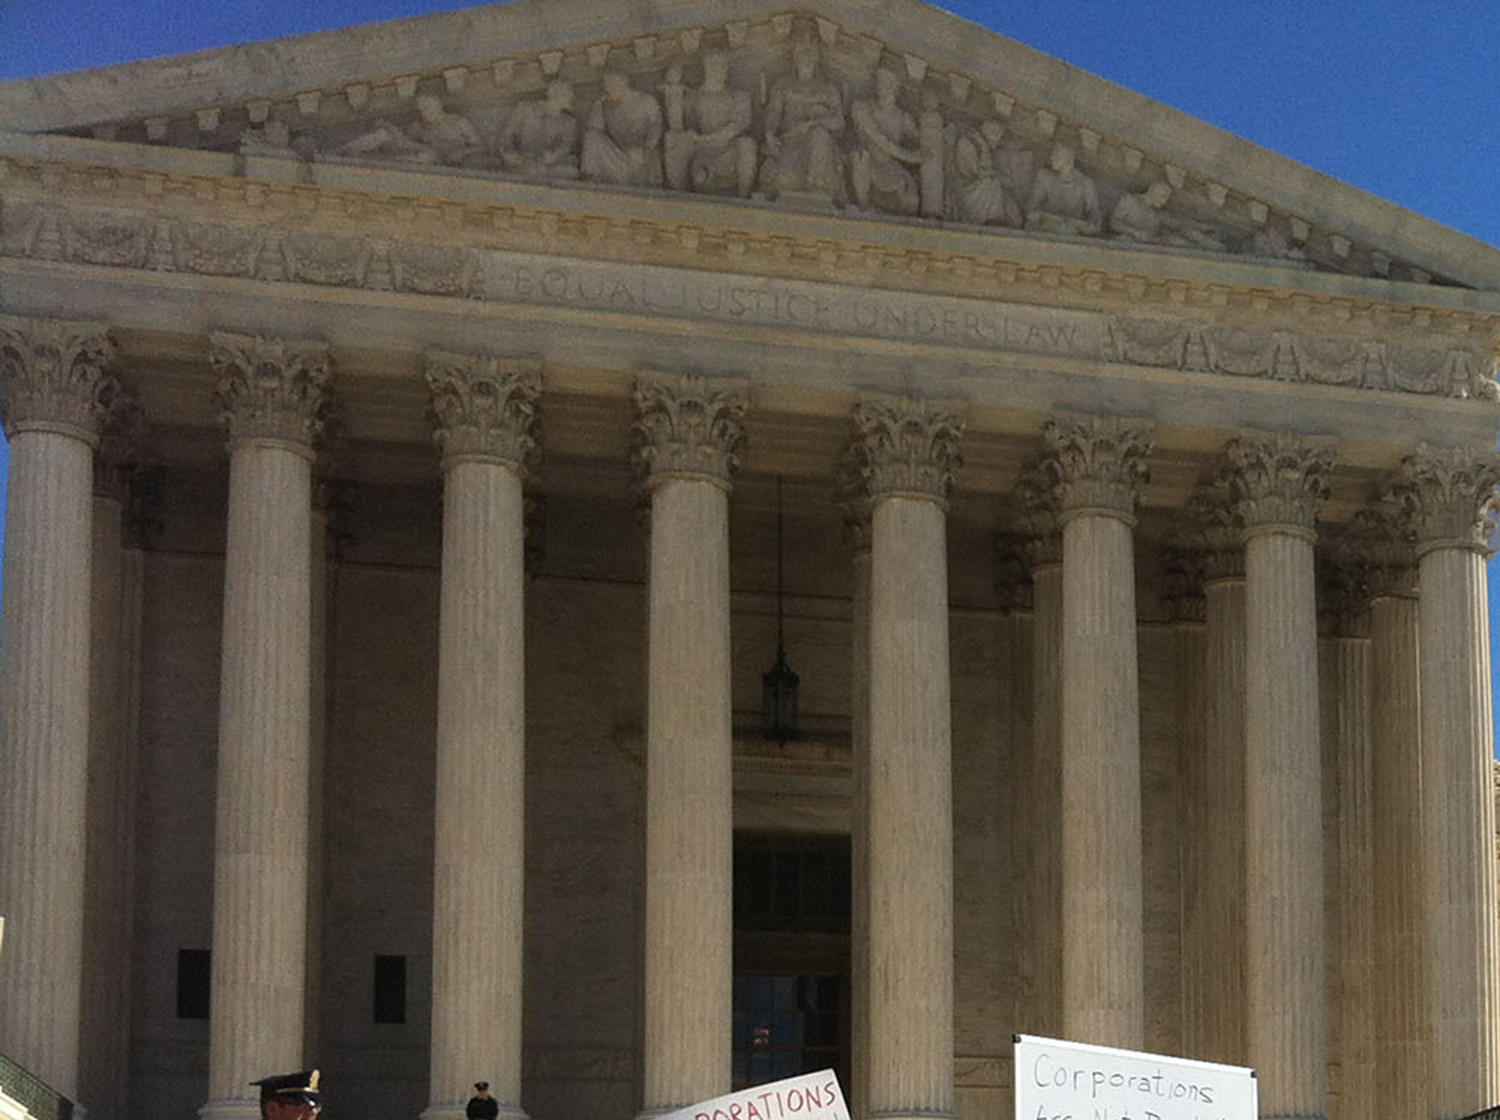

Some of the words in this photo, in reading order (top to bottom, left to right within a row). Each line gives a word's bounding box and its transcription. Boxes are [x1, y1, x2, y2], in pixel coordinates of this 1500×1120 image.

[514, 265, 669, 310] EQUAL
[678, 282, 829, 322] JUSTICE
[852, 303, 986, 338] UNDER
[1002, 318, 1079, 348] LAW
[1034, 1054, 1214, 1104] Corporations
